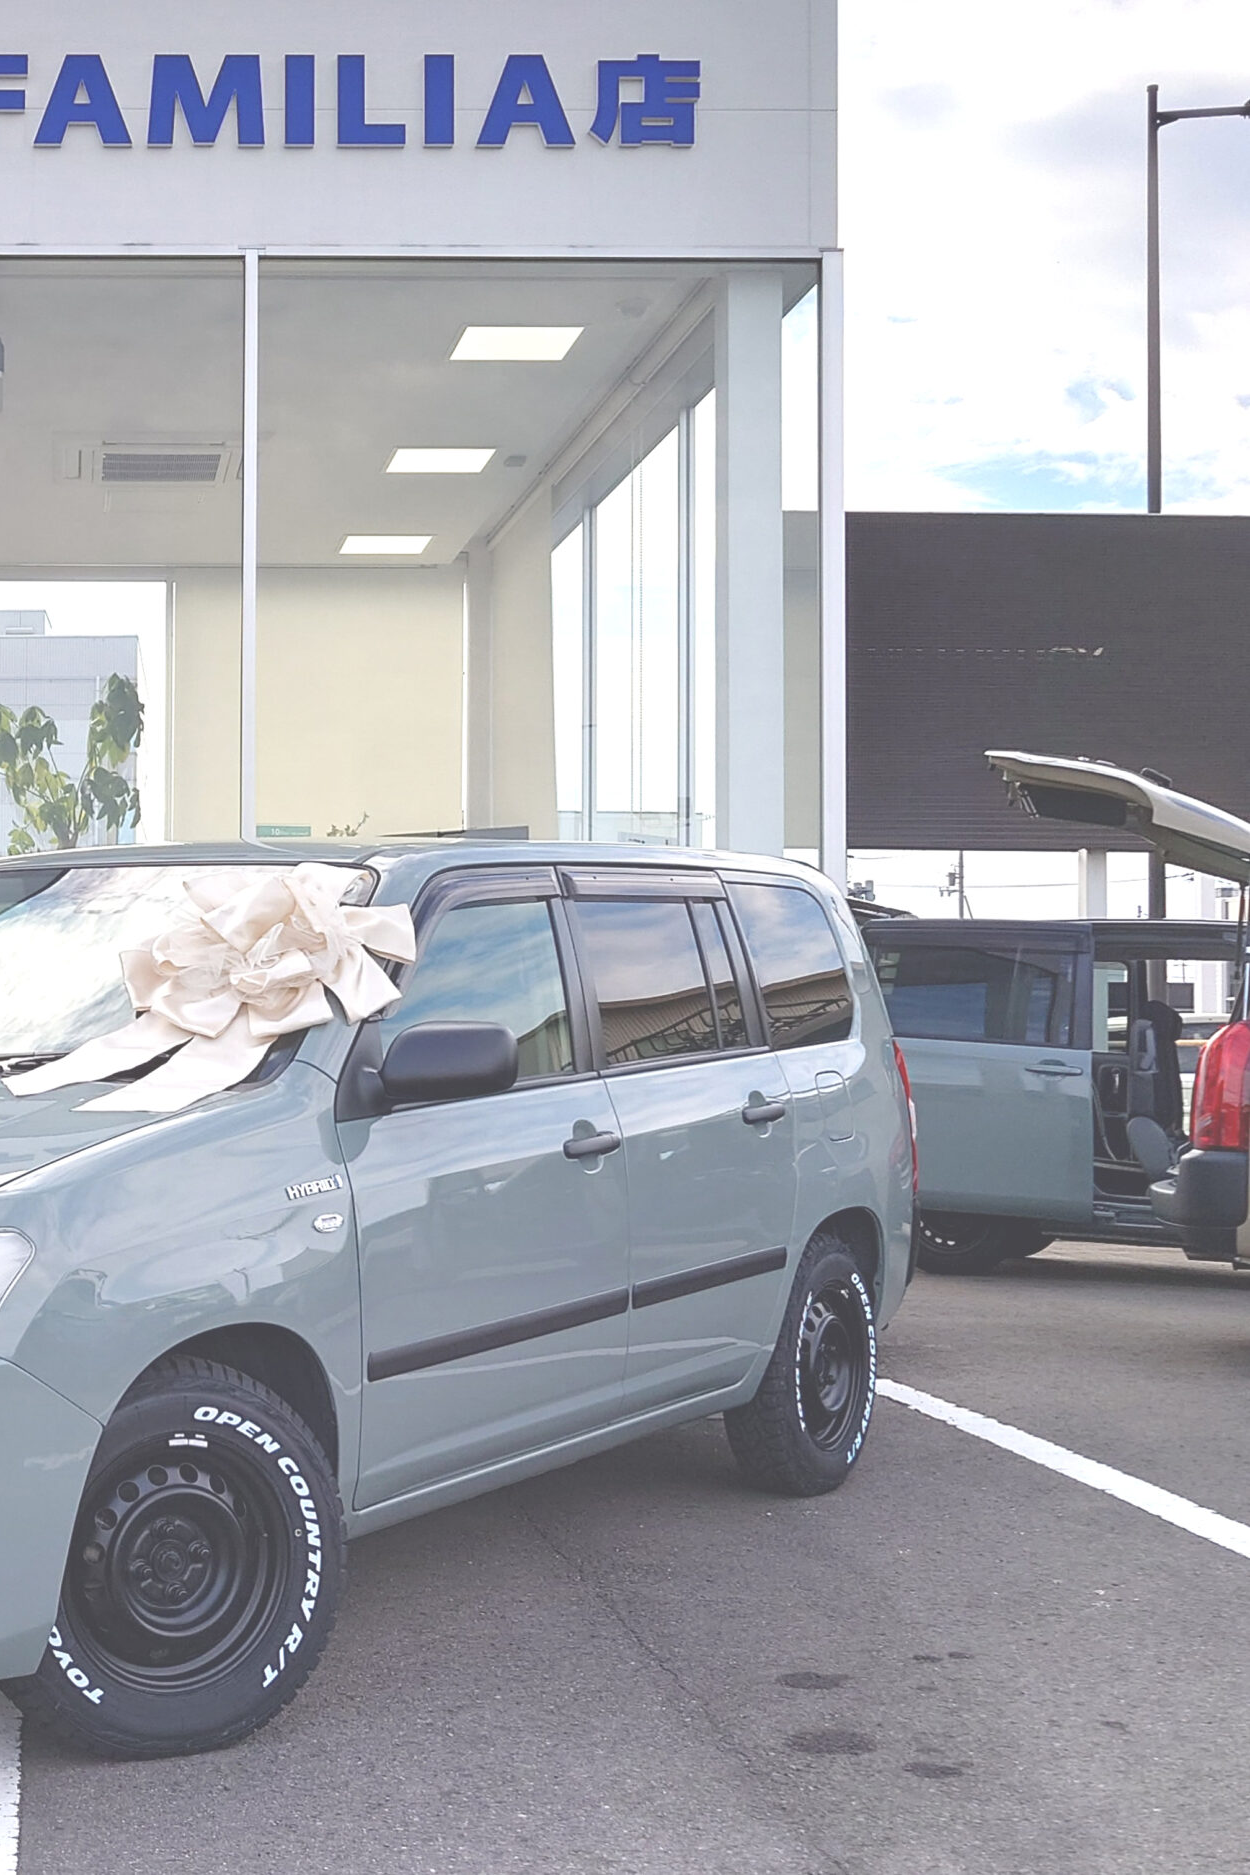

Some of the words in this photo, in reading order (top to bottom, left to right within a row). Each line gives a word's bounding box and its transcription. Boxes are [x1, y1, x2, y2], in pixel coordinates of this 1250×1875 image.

[285, 1176, 338, 1200] HYBRID
[851, 1273, 872, 1320] OPEN
[861, 1324, 876, 1434] COUNTRY
[193, 1405, 282, 1454] OPEN
[277, 1455, 323, 1622] COUNTRY
[48, 1625, 105, 1705] TOYO
[261, 1622, 305, 1689] R/T
